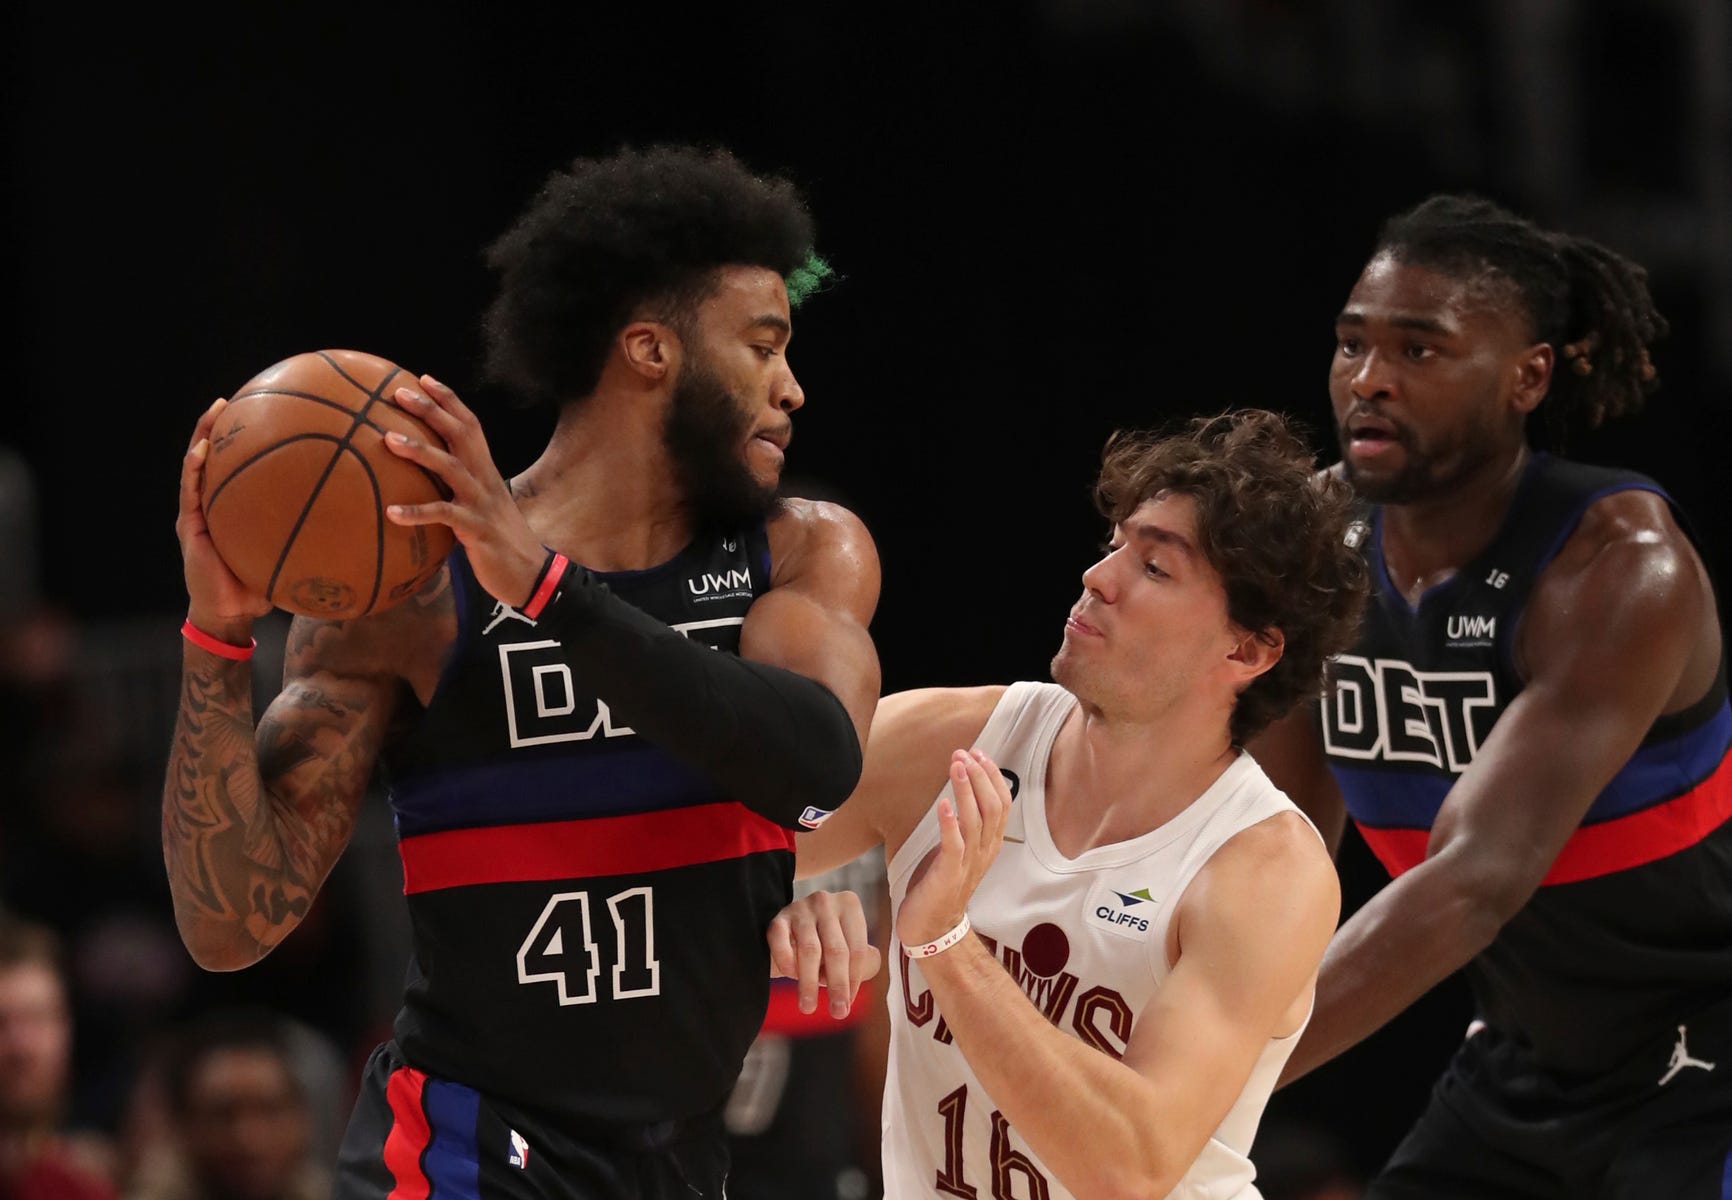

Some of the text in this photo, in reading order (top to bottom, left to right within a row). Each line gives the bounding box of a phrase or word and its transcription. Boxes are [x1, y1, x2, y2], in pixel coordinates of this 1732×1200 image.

[688, 567, 752, 595] UWM
[1485, 569, 1510, 589] 16
[1447, 615, 1496, 639] UWM
[1320, 653, 1496, 773] DET
[1096, 906, 1149, 931] CLIFFS
[516, 886, 660, 1006] 41
